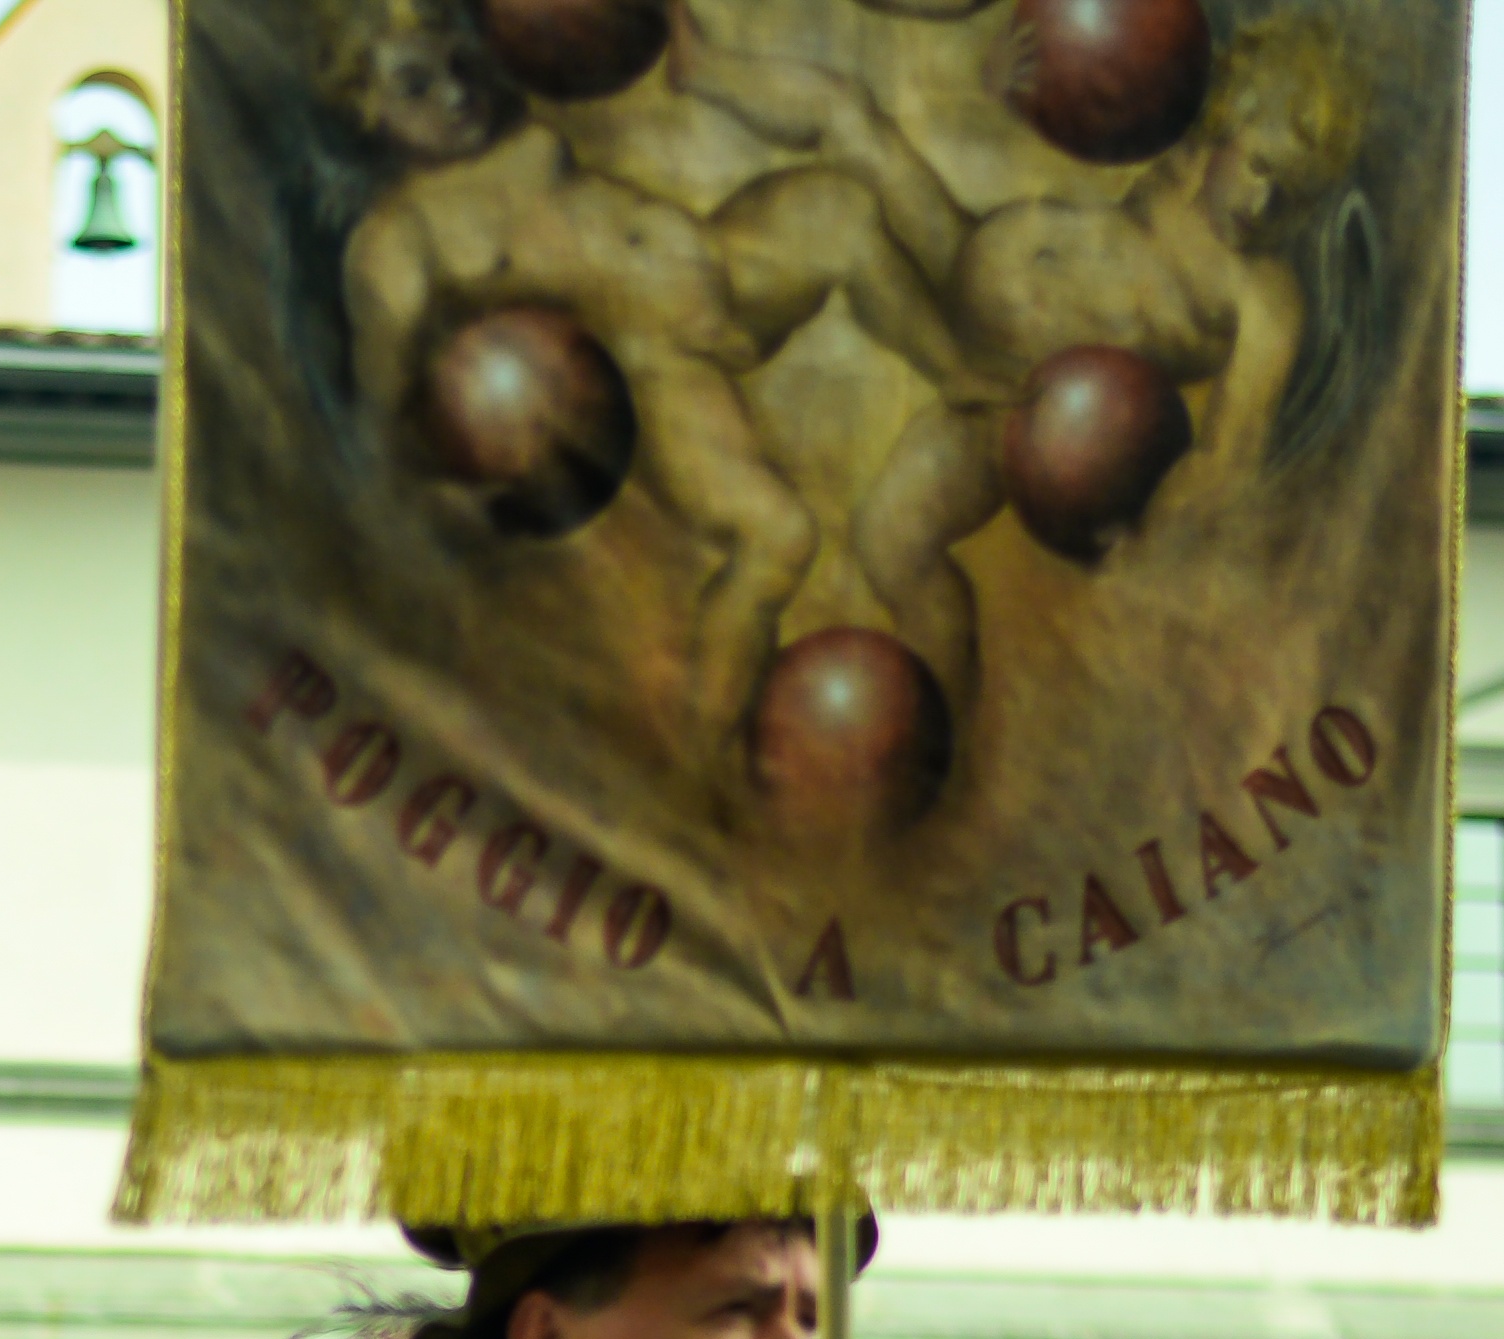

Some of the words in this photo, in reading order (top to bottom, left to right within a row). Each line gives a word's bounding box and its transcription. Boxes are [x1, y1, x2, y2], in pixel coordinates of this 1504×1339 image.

[243, 646, 673, 970] POGGIO
[795, 914, 856, 1000] A
[994, 704, 1377, 987] CAIANO
